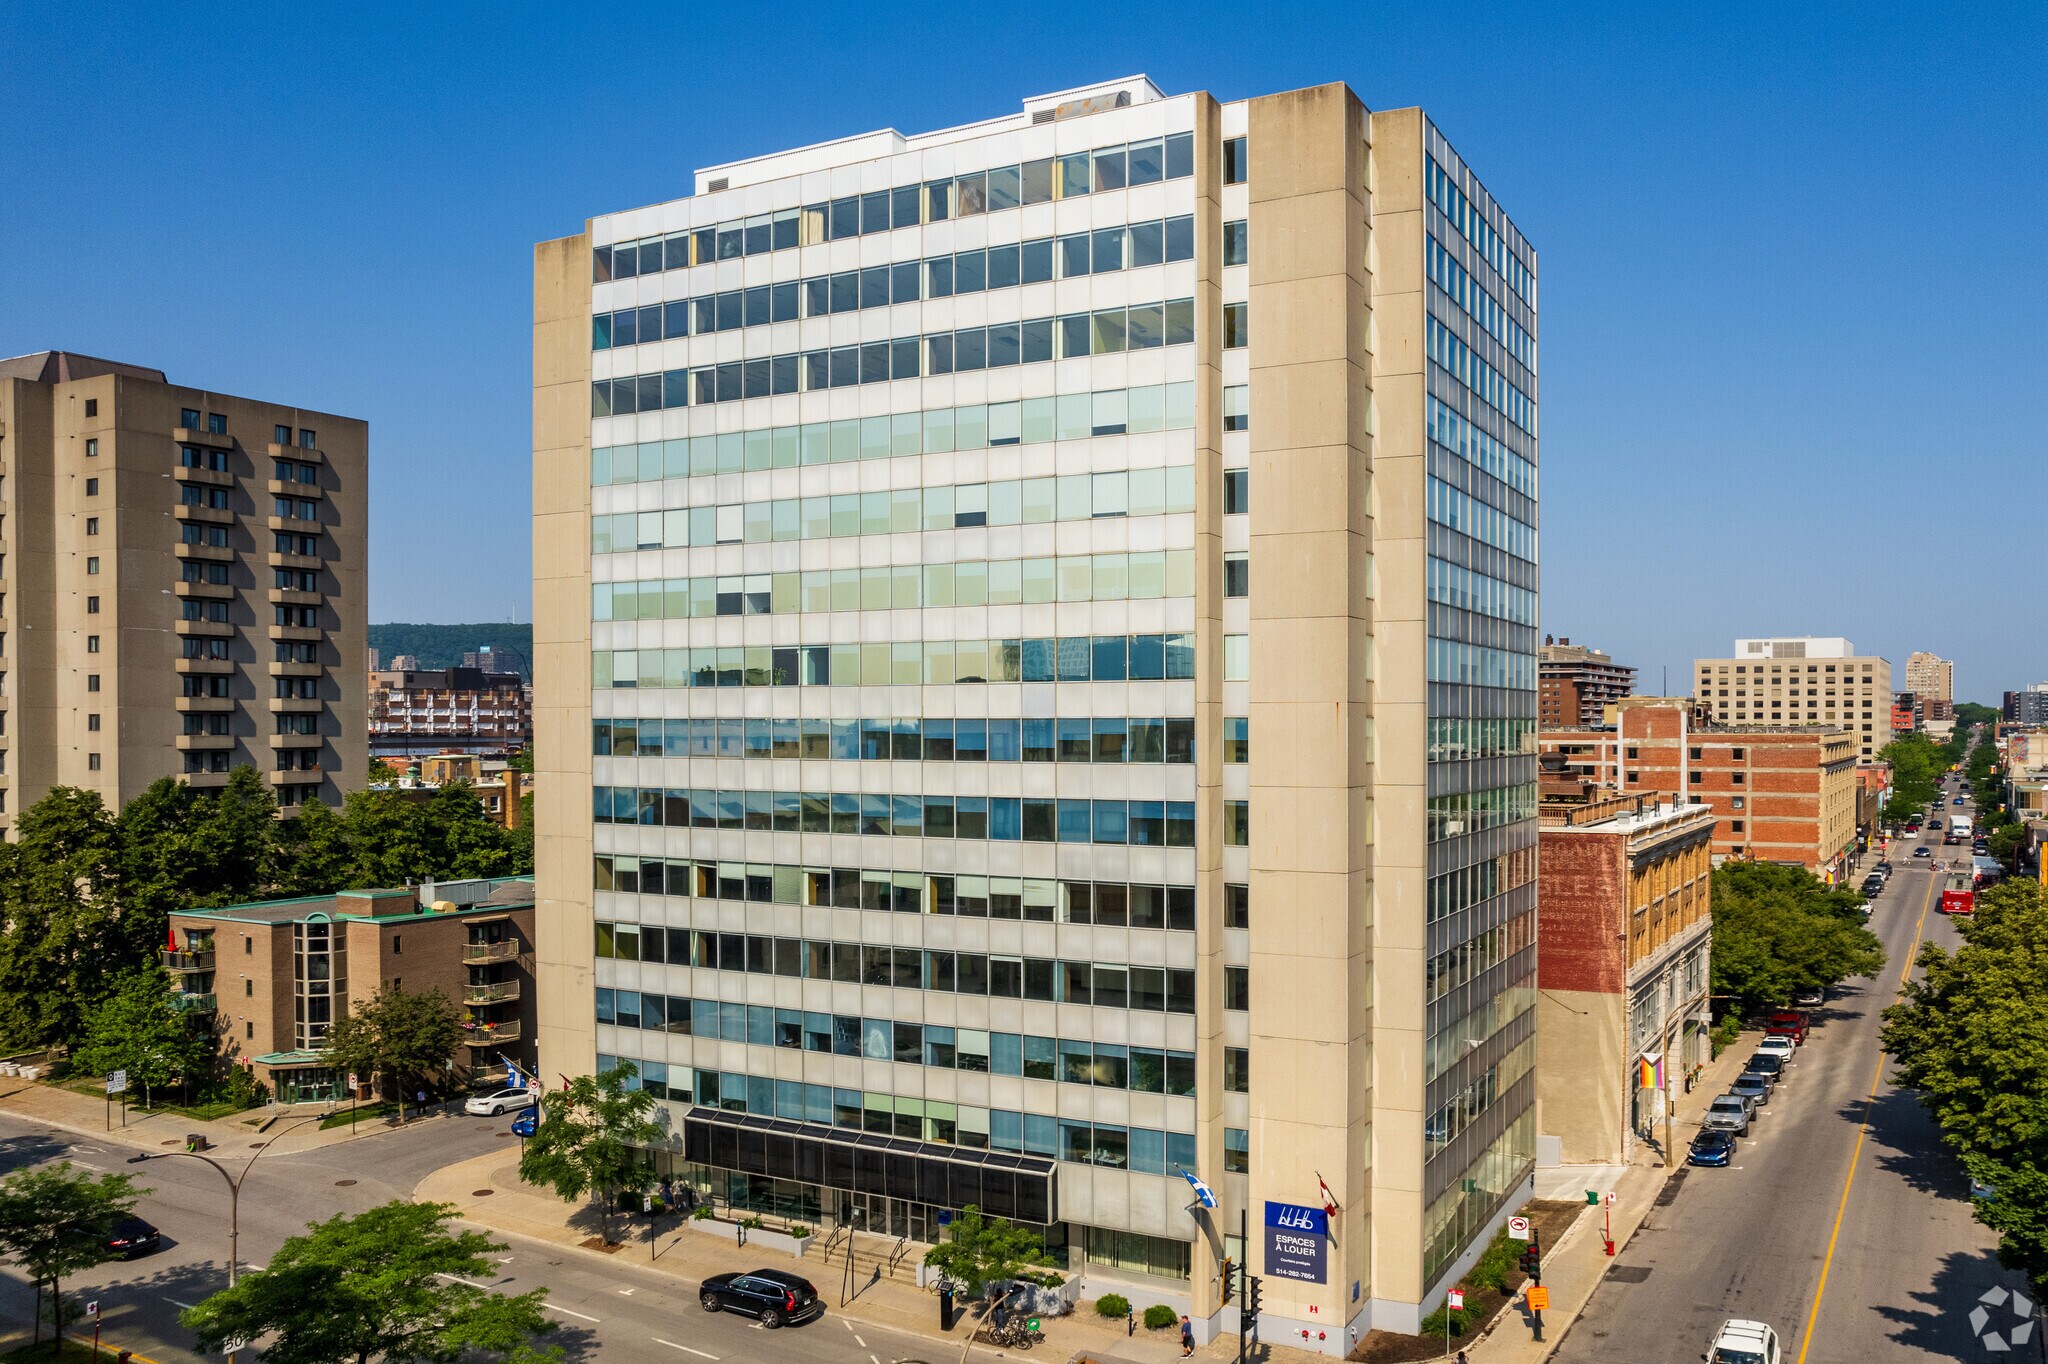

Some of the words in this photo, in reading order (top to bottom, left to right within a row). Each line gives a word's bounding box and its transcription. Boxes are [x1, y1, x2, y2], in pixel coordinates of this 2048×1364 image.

[1276, 1234, 1315, 1248] ESPACES
[1276, 1242, 1282, 1251] À
[1284, 1245, 1316, 1256] LOUER
[226, 1337, 242, 1350] 50
